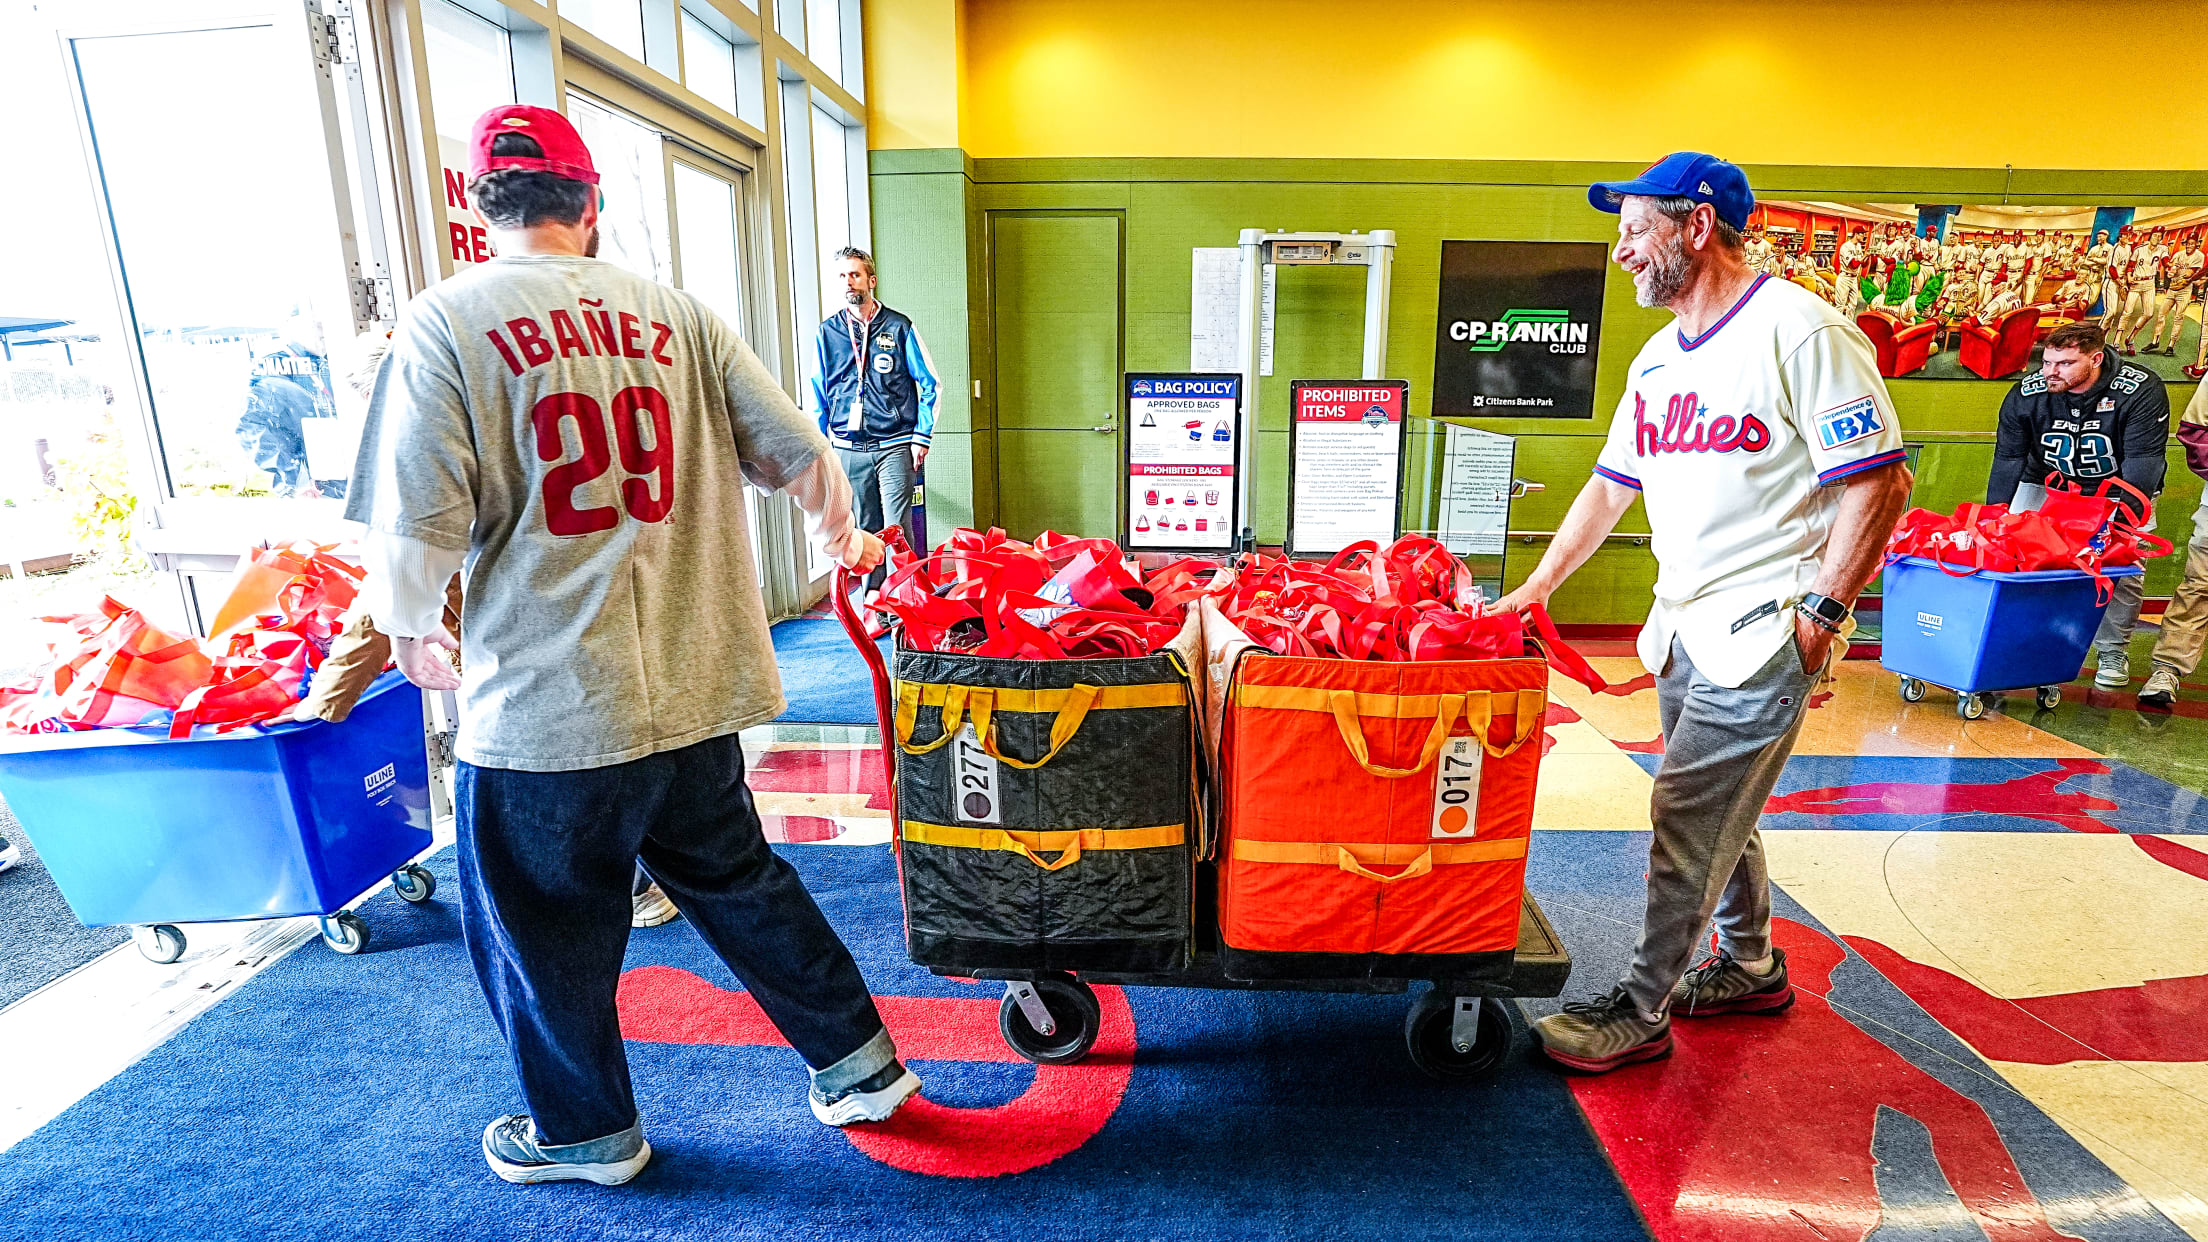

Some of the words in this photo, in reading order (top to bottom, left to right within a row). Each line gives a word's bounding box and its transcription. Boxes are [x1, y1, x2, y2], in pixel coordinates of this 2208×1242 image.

[444, 168, 471, 210] N
[449, 222, 498, 263] RE
[486, 298, 673, 377] IBAÑEZ
[1449, 321, 1487, 341] CP
[1491, 321, 1589, 342] RANKIN
[1549, 343, 1587, 354] CLUB
[1154, 382, 1182, 394] BAG
[1185, 382, 1233, 394] POLICY
[1303, 389, 1391, 402] PROHIBITED
[1302, 405, 1346, 417] ITEMS
[1486, 397, 1516, 406] Citizens
[1516, 397, 1535, 406] Bank
[1536, 398, 1554, 407] Park
[1820, 408, 1881, 446] IBX
[532, 386, 674, 536] 29
[2041, 432, 2119, 478] 33
[1143, 466, 1197, 475] PROHIBITED
[1199, 467, 1222, 475] BAGS
[1919, 613, 1941, 624] ULINE
[960, 740, 989, 790] 277
[366, 766, 393, 788] ULINE
[1441, 756, 1473, 804] 017
